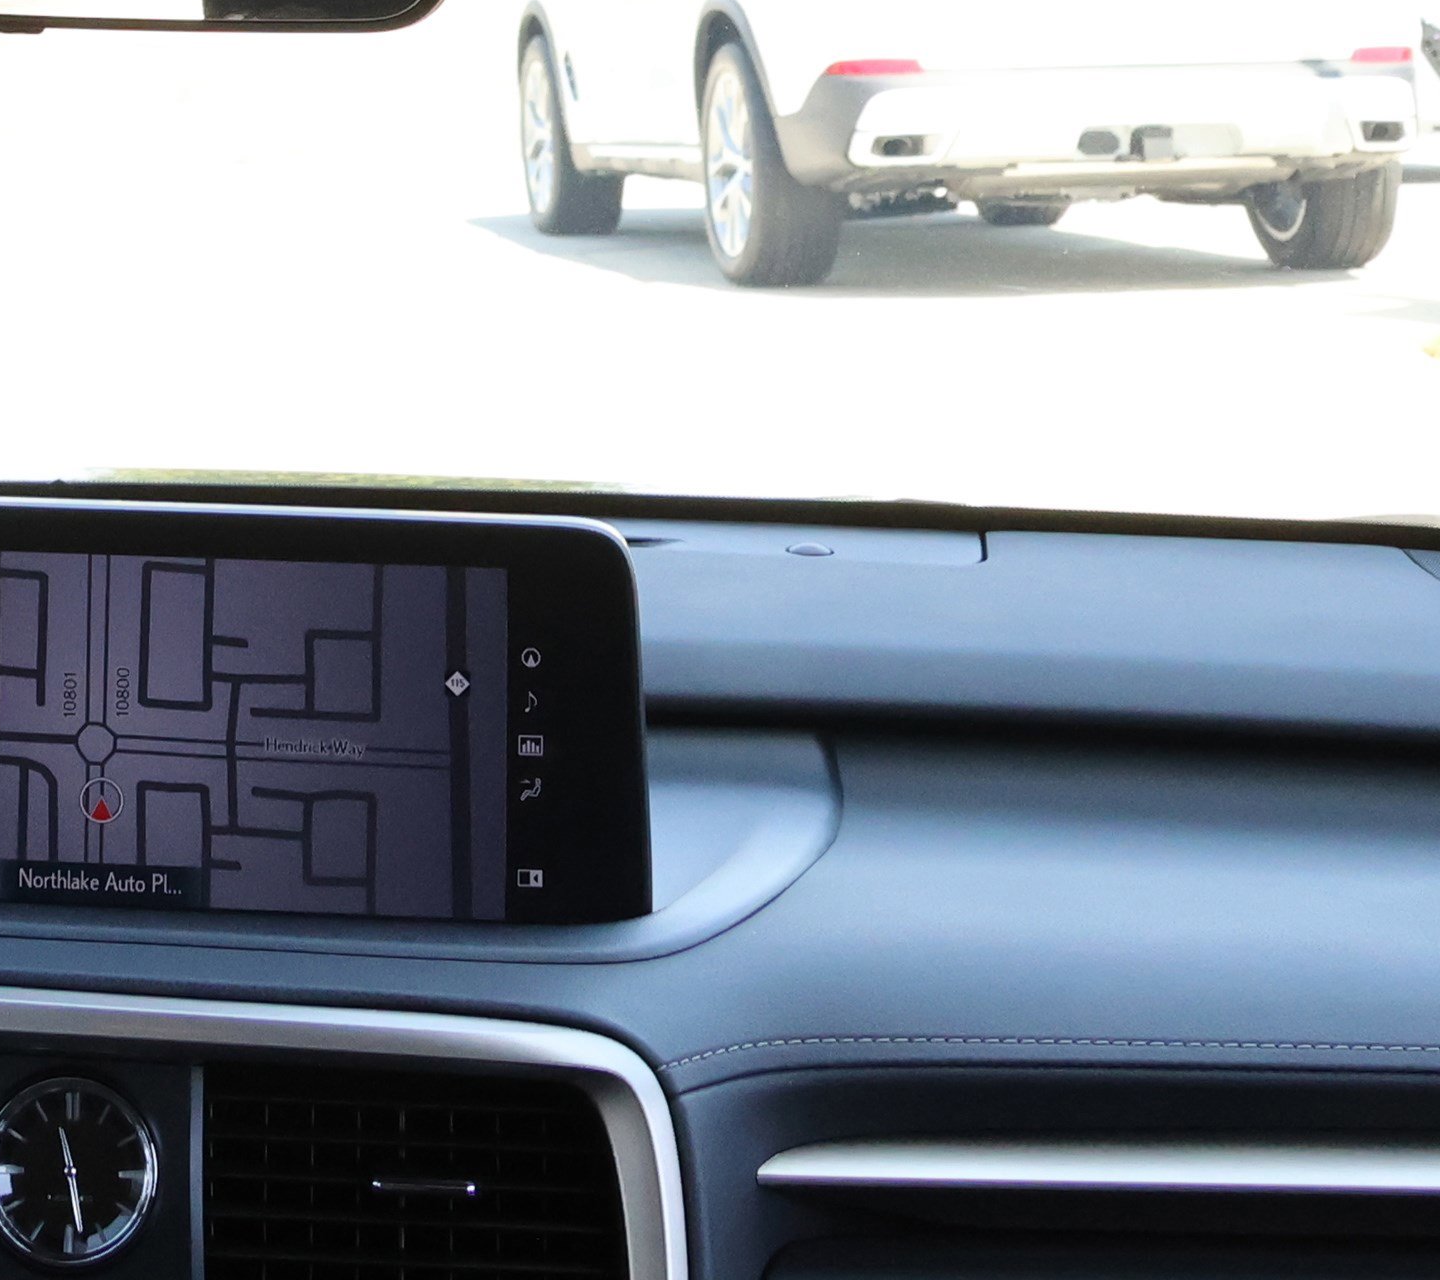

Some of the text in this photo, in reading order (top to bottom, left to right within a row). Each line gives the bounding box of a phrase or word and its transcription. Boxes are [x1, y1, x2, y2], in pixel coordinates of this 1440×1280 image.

[63, 672, 77, 717] 10801
[116, 668, 129, 716] 10800
[451, 679, 466, 688] 115
[265, 737, 366, 759] Hendrick Way
[19, 868, 182, 894] Northlake Auto Pl...
